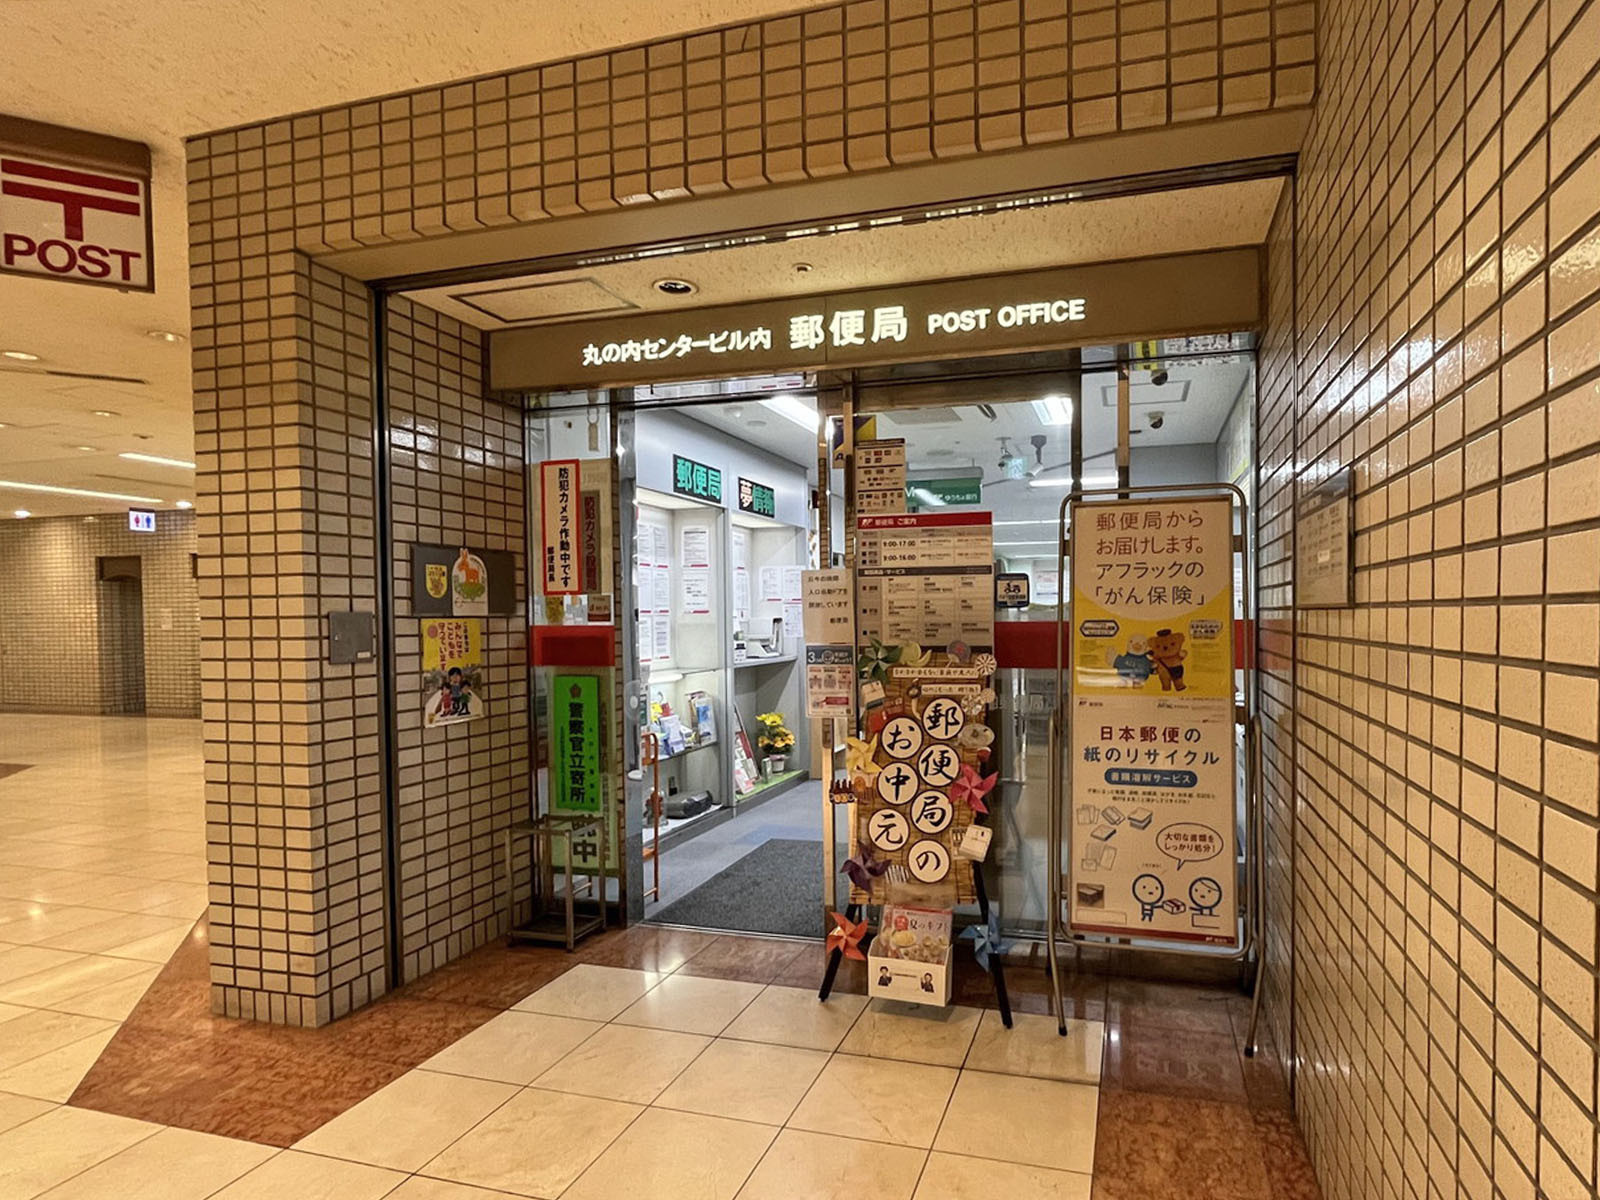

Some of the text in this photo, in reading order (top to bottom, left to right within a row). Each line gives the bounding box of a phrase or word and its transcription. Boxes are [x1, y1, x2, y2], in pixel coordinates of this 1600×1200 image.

[3, 233, 141, 281] POST
[582, 299, 1085, 367] 丸の内センタービル内 郵便局 POST OFFICE
[676, 458, 721, 500] 郵便局
[558, 467, 571, 588] 防犯カメラ作動中です
[1096, 509, 1204, 532] 郵便局から
[1096, 535, 1204, 556] お届けします。
[1096, 560, 1204, 580] アフラックの
[1095, 585, 1206, 606] 「がん保険」
[1100, 725, 1201, 744] 日本郵便の
[568, 702, 586, 804] 警察官立寄所
[1083, 745, 1220, 766] 紙のリサイクル
[1110, 771, 1192, 784] 書類溶解サービス
[1164, 831, 1215, 843] 大切な書類を
[1164, 843, 1216, 853] しっかり処分!
